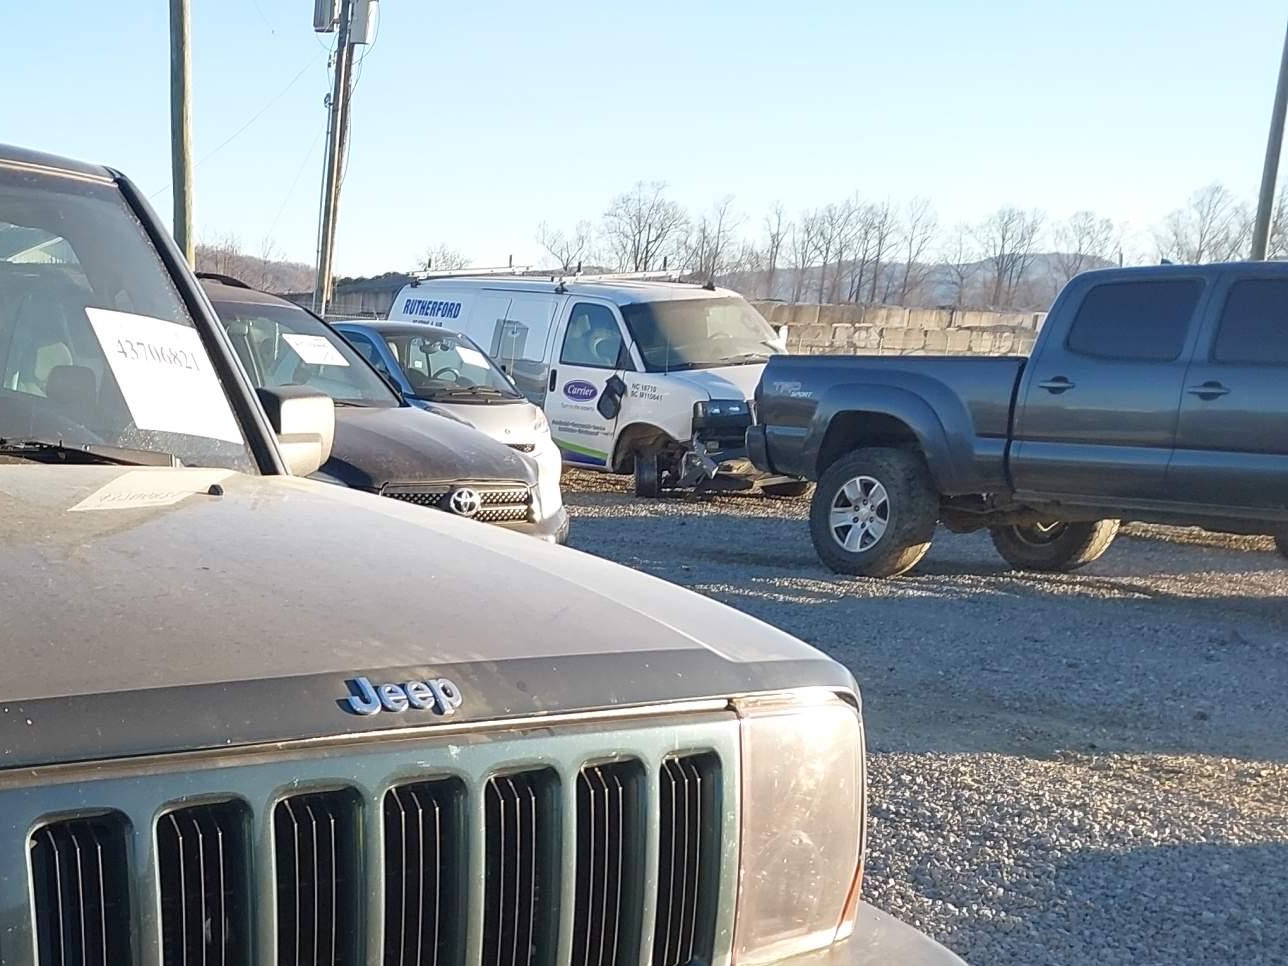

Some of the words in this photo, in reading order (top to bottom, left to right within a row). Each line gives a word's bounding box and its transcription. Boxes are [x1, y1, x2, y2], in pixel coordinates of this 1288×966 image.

[403, 298, 462, 319] RUTHERFORD
[567, 384, 594, 397] Carrier
[346, 676, 462, 715] Jeep
